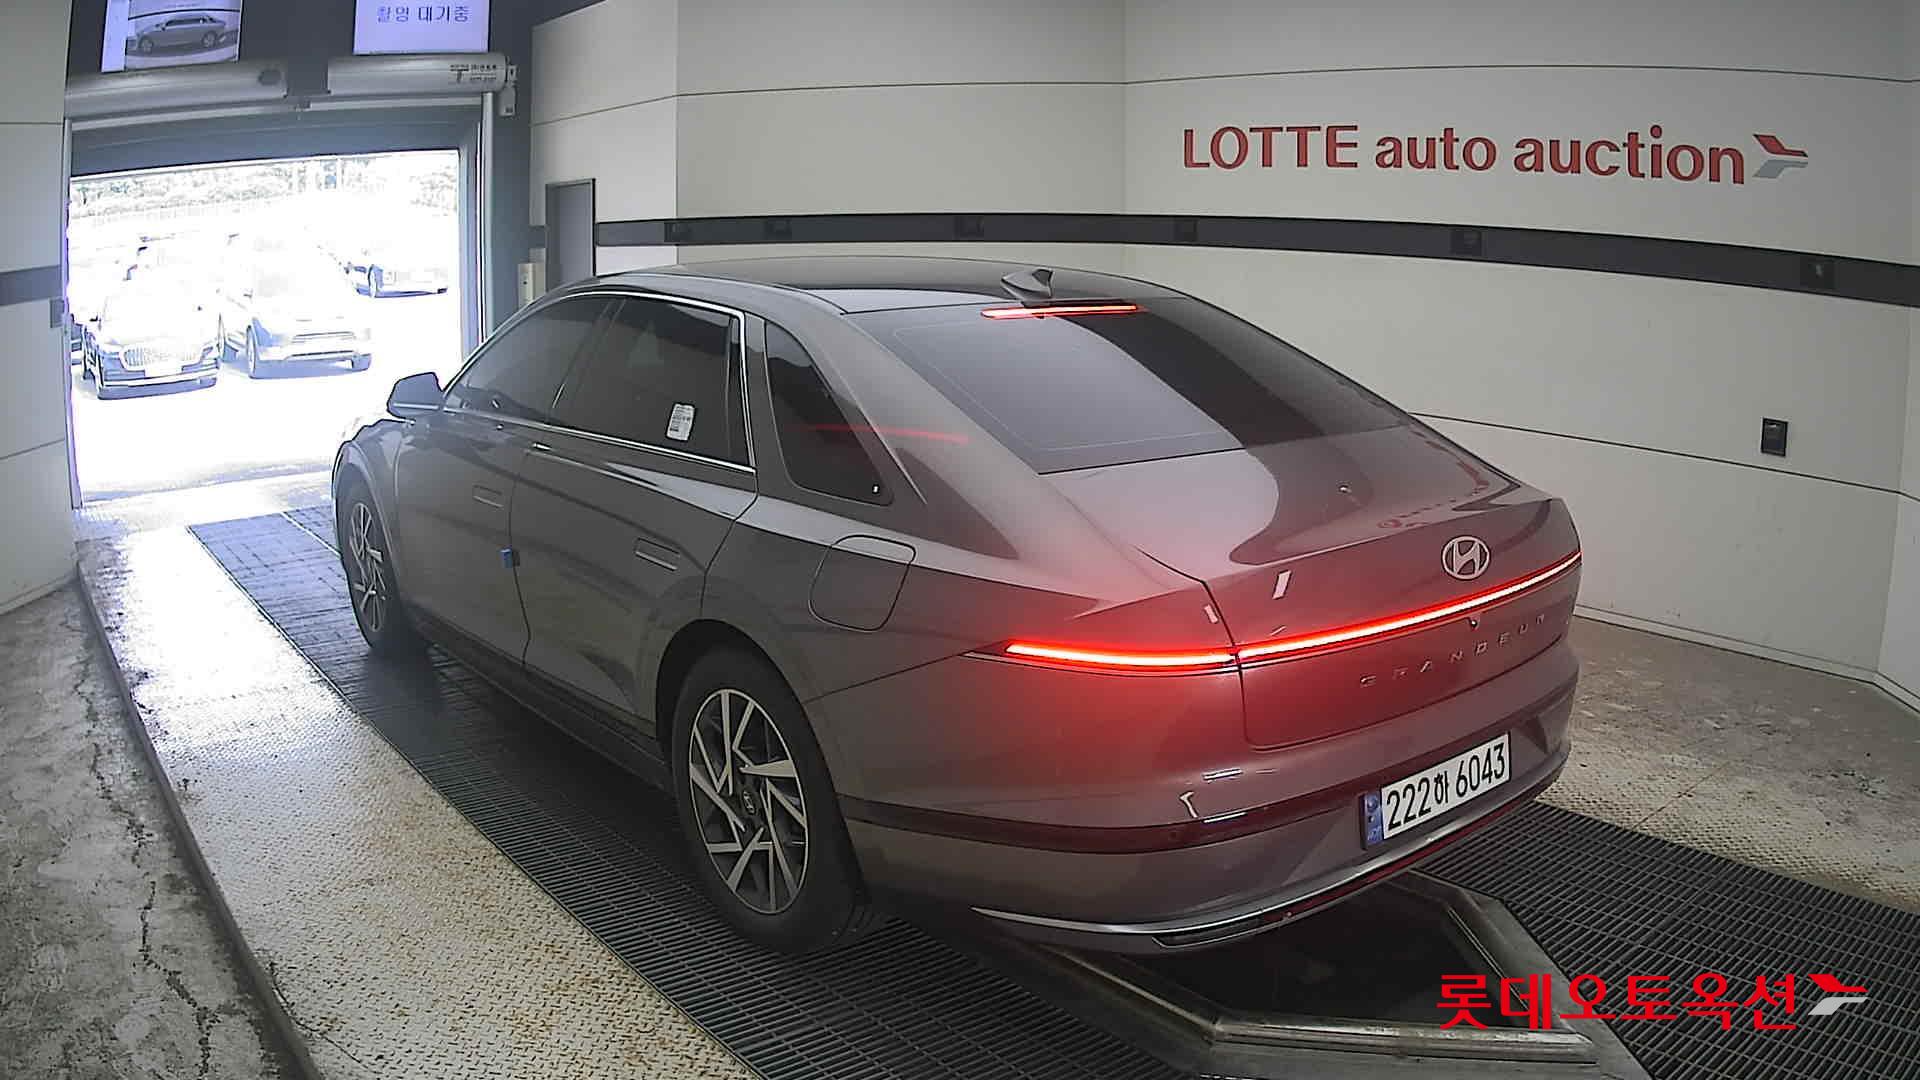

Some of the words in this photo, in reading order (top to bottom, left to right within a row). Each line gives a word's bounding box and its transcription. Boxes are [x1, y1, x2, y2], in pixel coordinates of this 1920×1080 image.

[418, 6, 469, 23] 대기중
[1183, 125, 1359, 170] LOTTE
[1375, 127, 1498, 171] auto
[1512, 124, 1745, 185] auction
[1386, 770, 1449, 831] 222하
[1455, 742, 1506, 798] 6043
